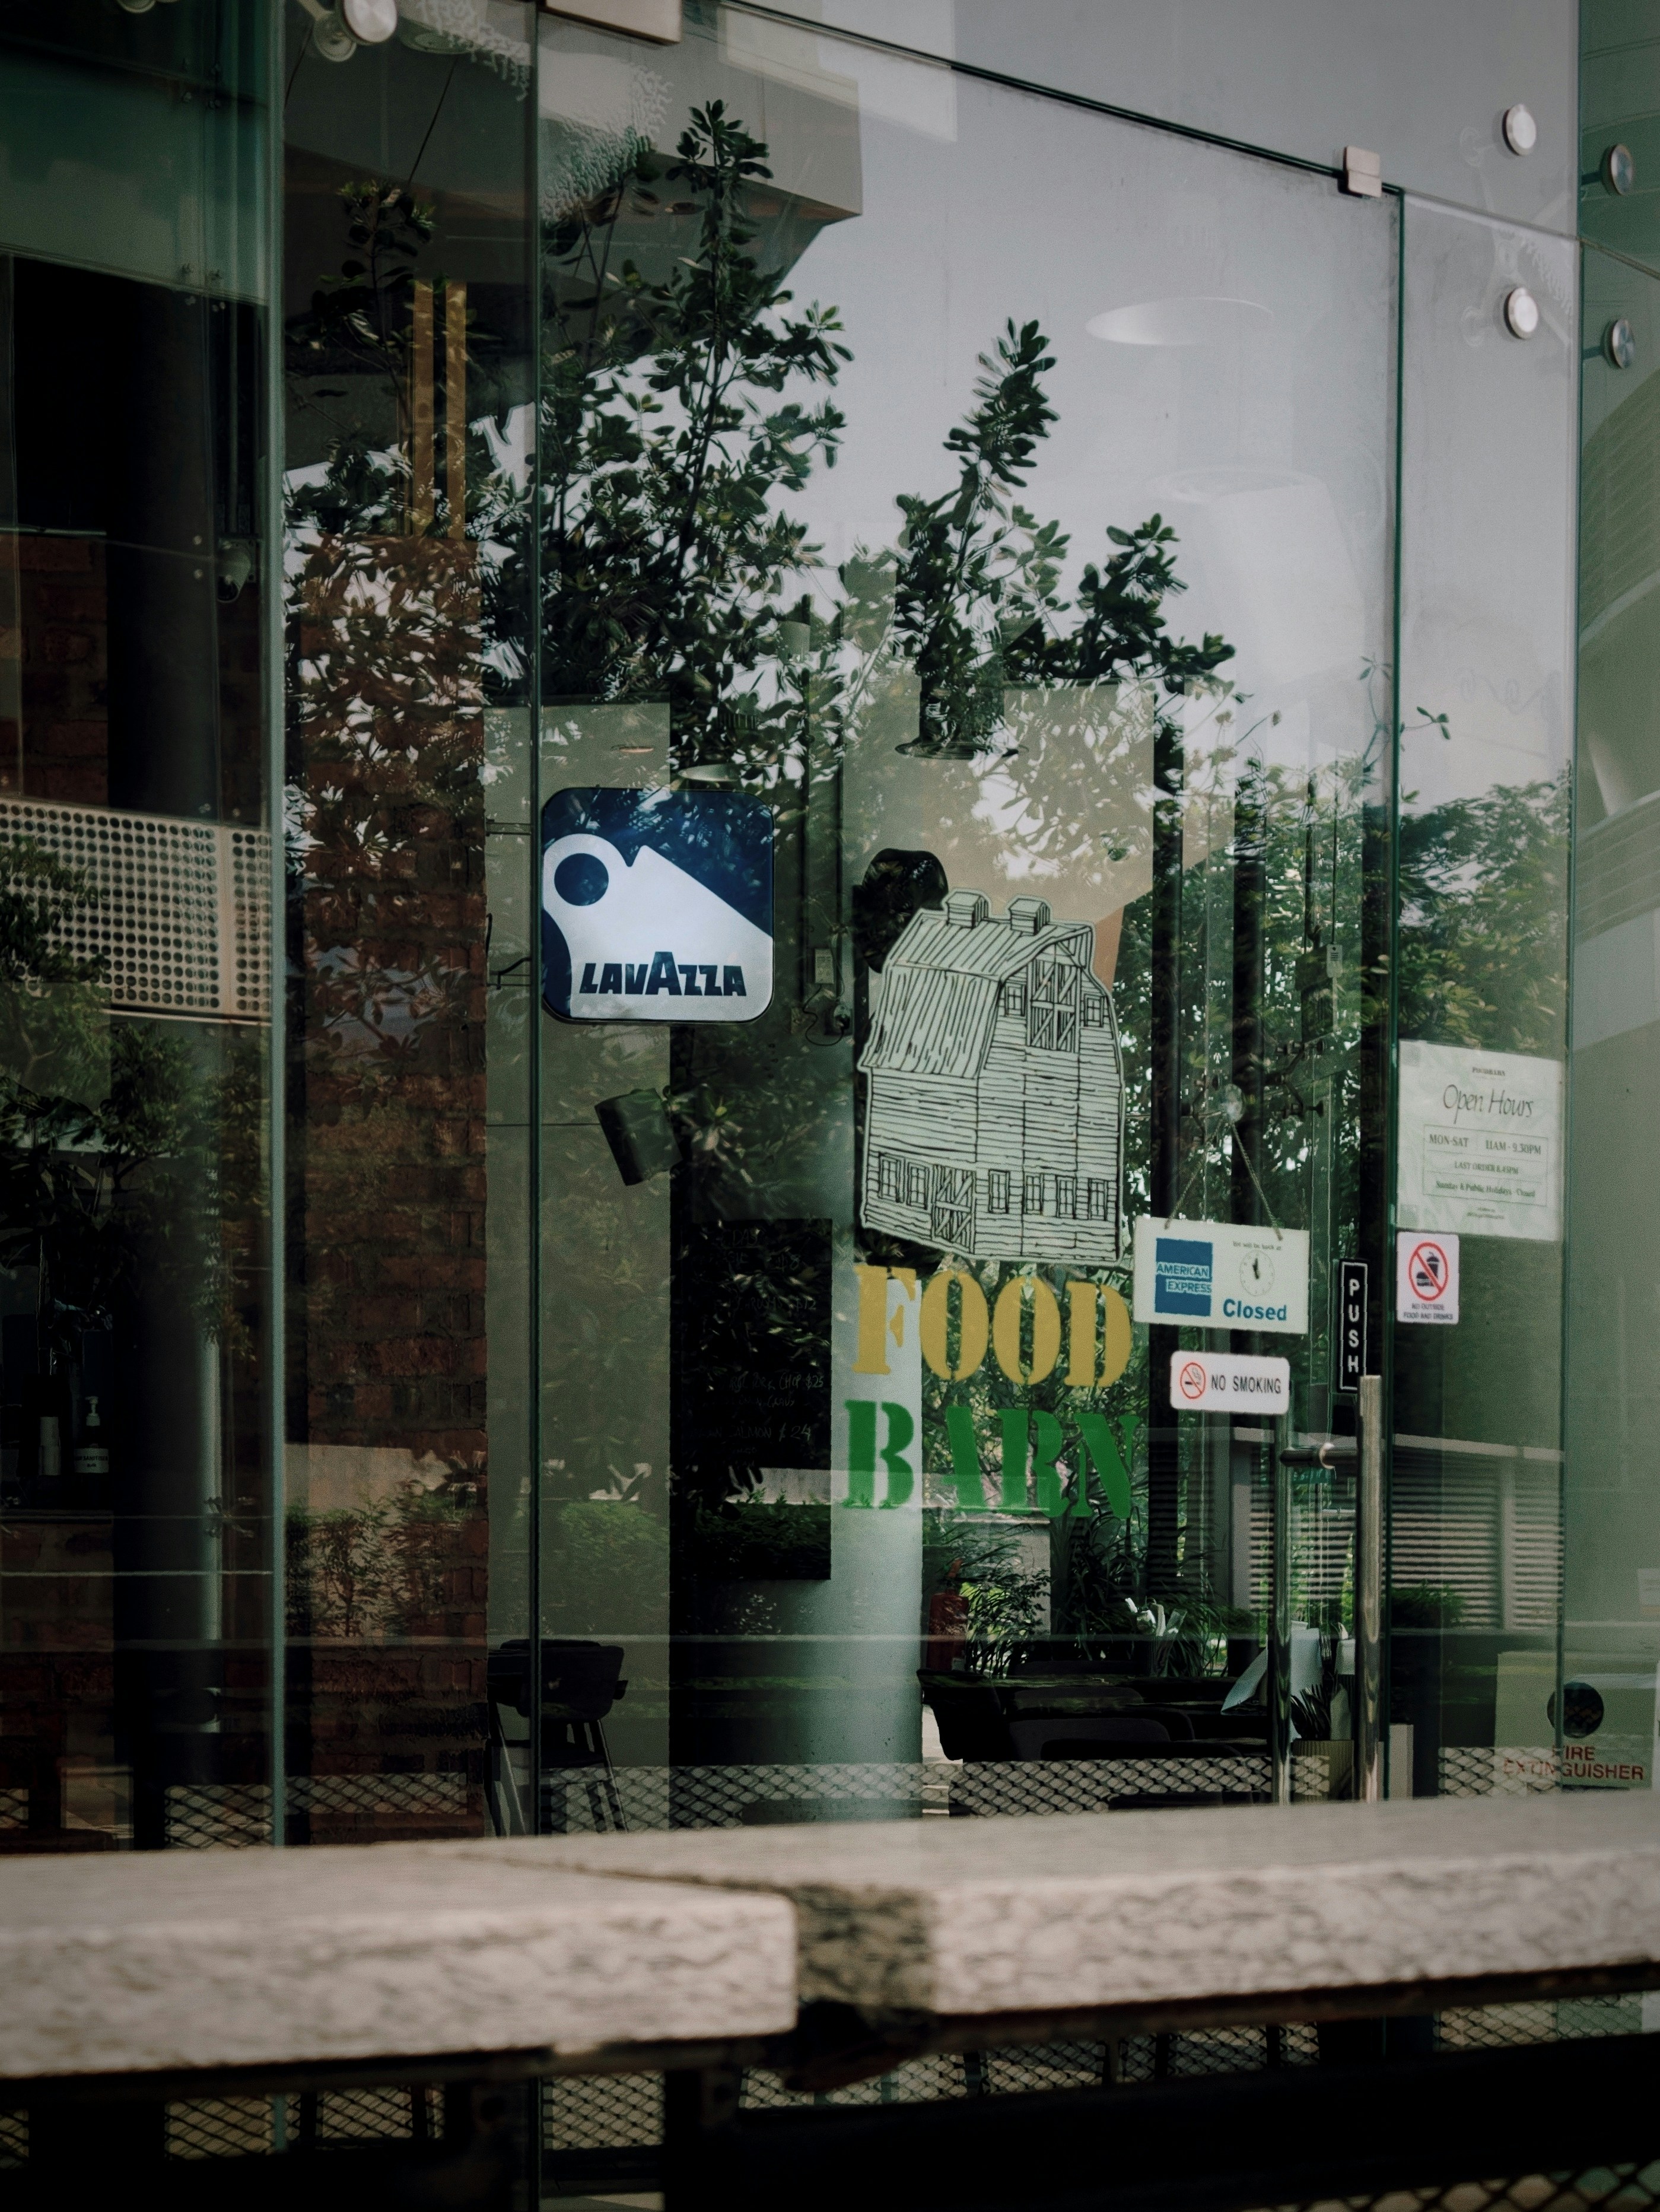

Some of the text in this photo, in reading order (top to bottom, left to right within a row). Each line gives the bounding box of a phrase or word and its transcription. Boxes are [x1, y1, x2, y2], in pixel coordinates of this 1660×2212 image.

[579, 951, 746, 996] LAVAZZA
[1443, 1085, 1534, 1124] Open Hours
[1429, 1134, 1468, 1148] MON-SAT
[1486, 1140, 1506, 1151] 11AM
[1454, 1161, 1471, 1170] LAST
[1156, 1263, 1209, 1277] AMERICAN
[1168, 1280, 1212, 1293] EXPRESS
[1223, 1298, 1287, 1321] Closed
[852, 1264, 1132, 1387] FOOD
[1347, 1279, 1360, 1374] PUSH
[1211, 1374, 1281, 1395] NO SMOKING
[841, 1399, 1140, 1517] BARN
